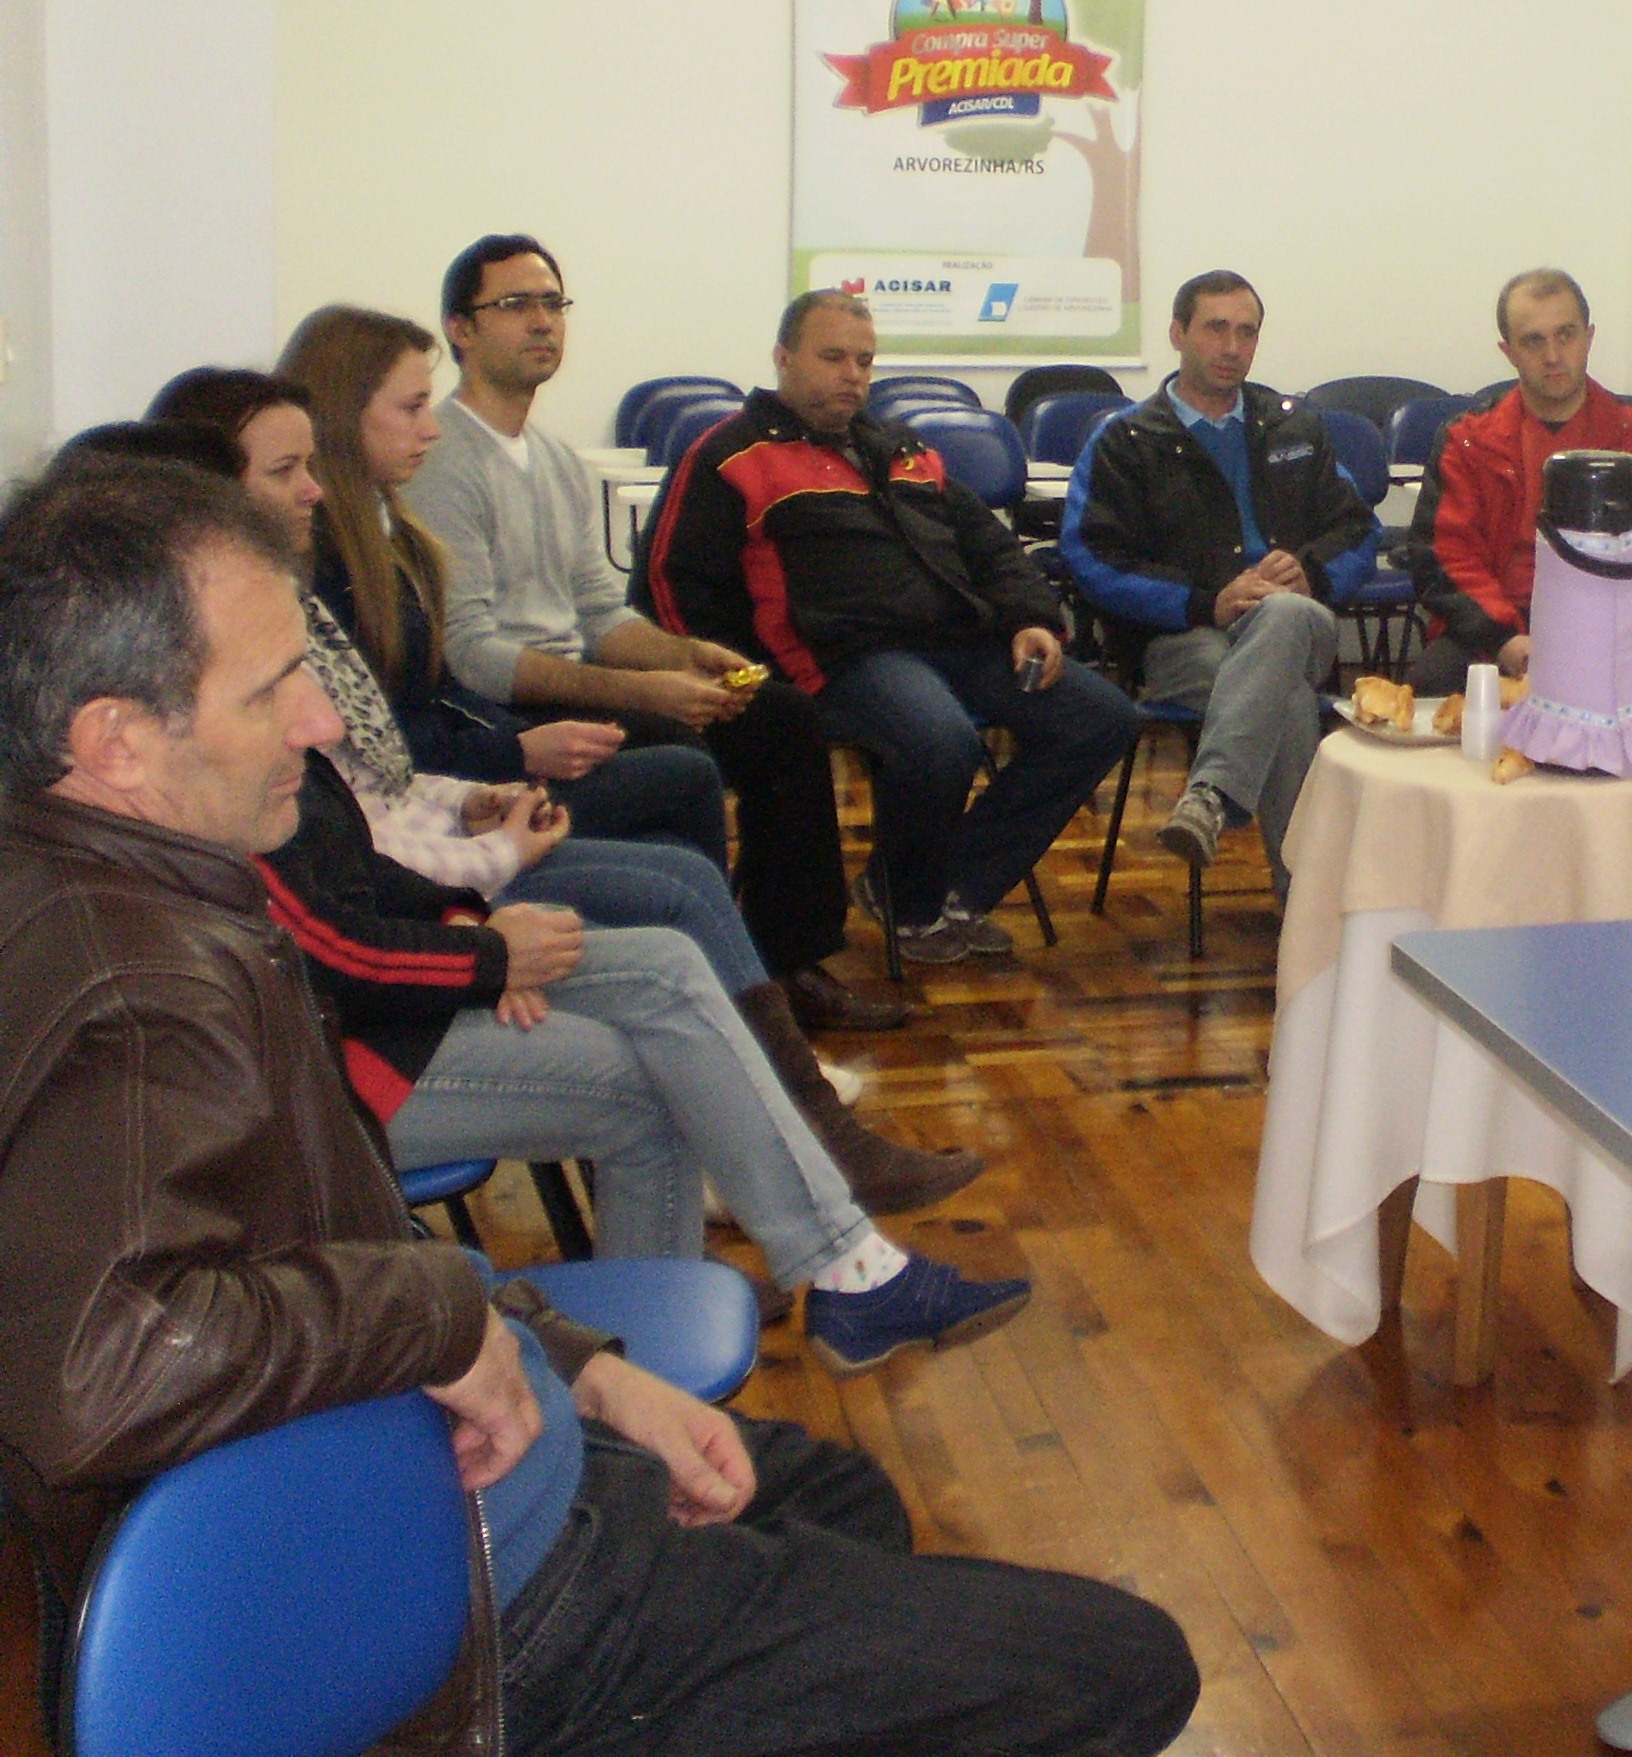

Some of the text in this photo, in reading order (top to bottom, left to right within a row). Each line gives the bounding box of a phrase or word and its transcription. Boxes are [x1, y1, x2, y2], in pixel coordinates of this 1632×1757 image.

[911, 29, 1046, 55] Compra Super
[887, 50, 1074, 101] Premiada
[948, 95, 1015, 115] ACISAR/CDL
[893, 157, 1045, 175] ARVOREZINHA/RS
[874, 280, 953, 294] ACISAR
